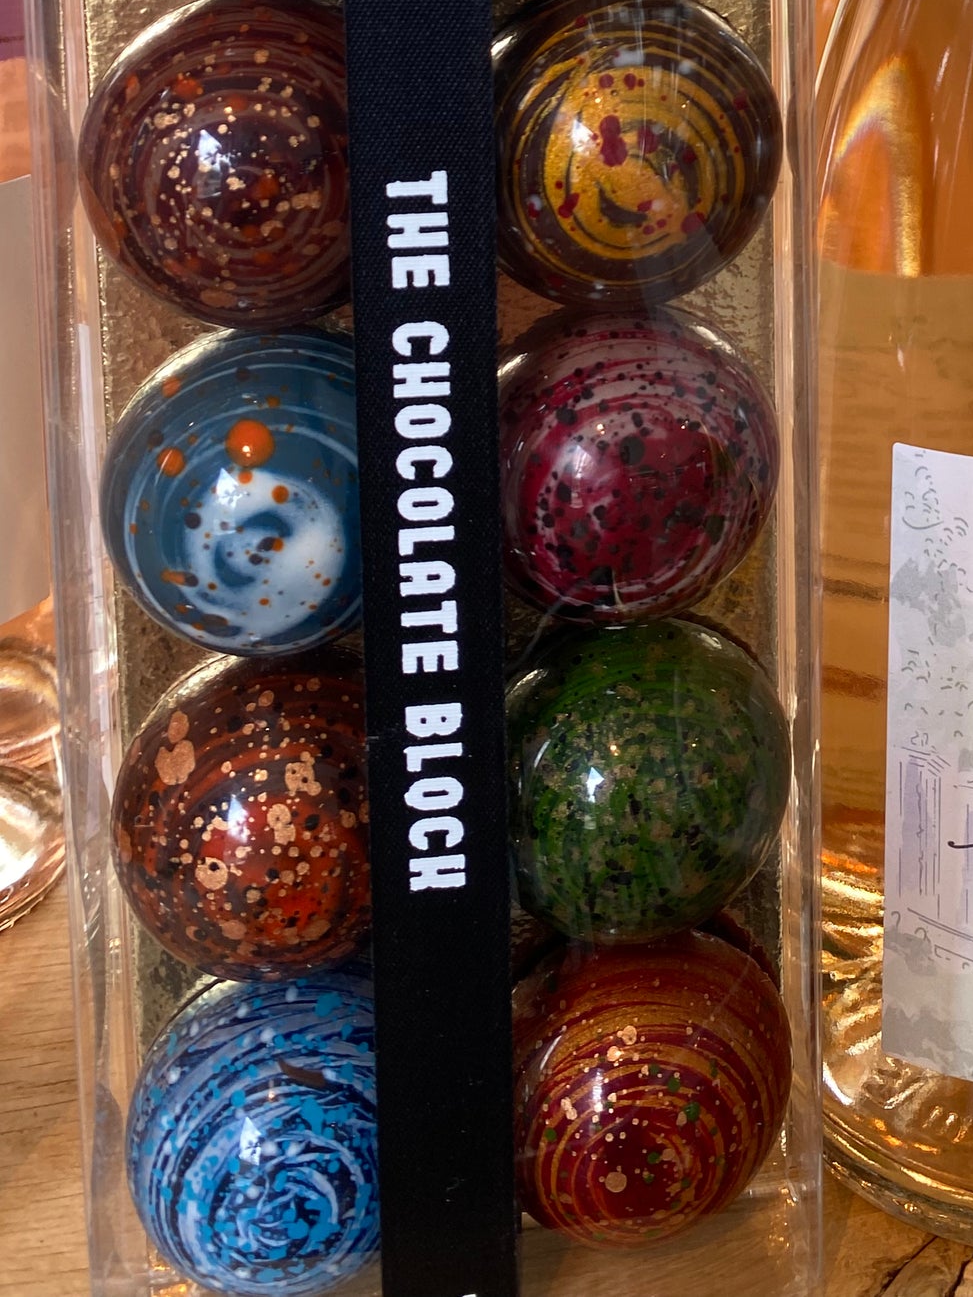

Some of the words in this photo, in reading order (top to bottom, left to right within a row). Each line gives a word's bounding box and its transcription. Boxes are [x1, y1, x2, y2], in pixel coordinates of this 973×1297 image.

[386, 170, 451, 289] THE
[391, 320, 460, 674] CHOCOLATE
[403, 702, 466, 892] BLOCH
